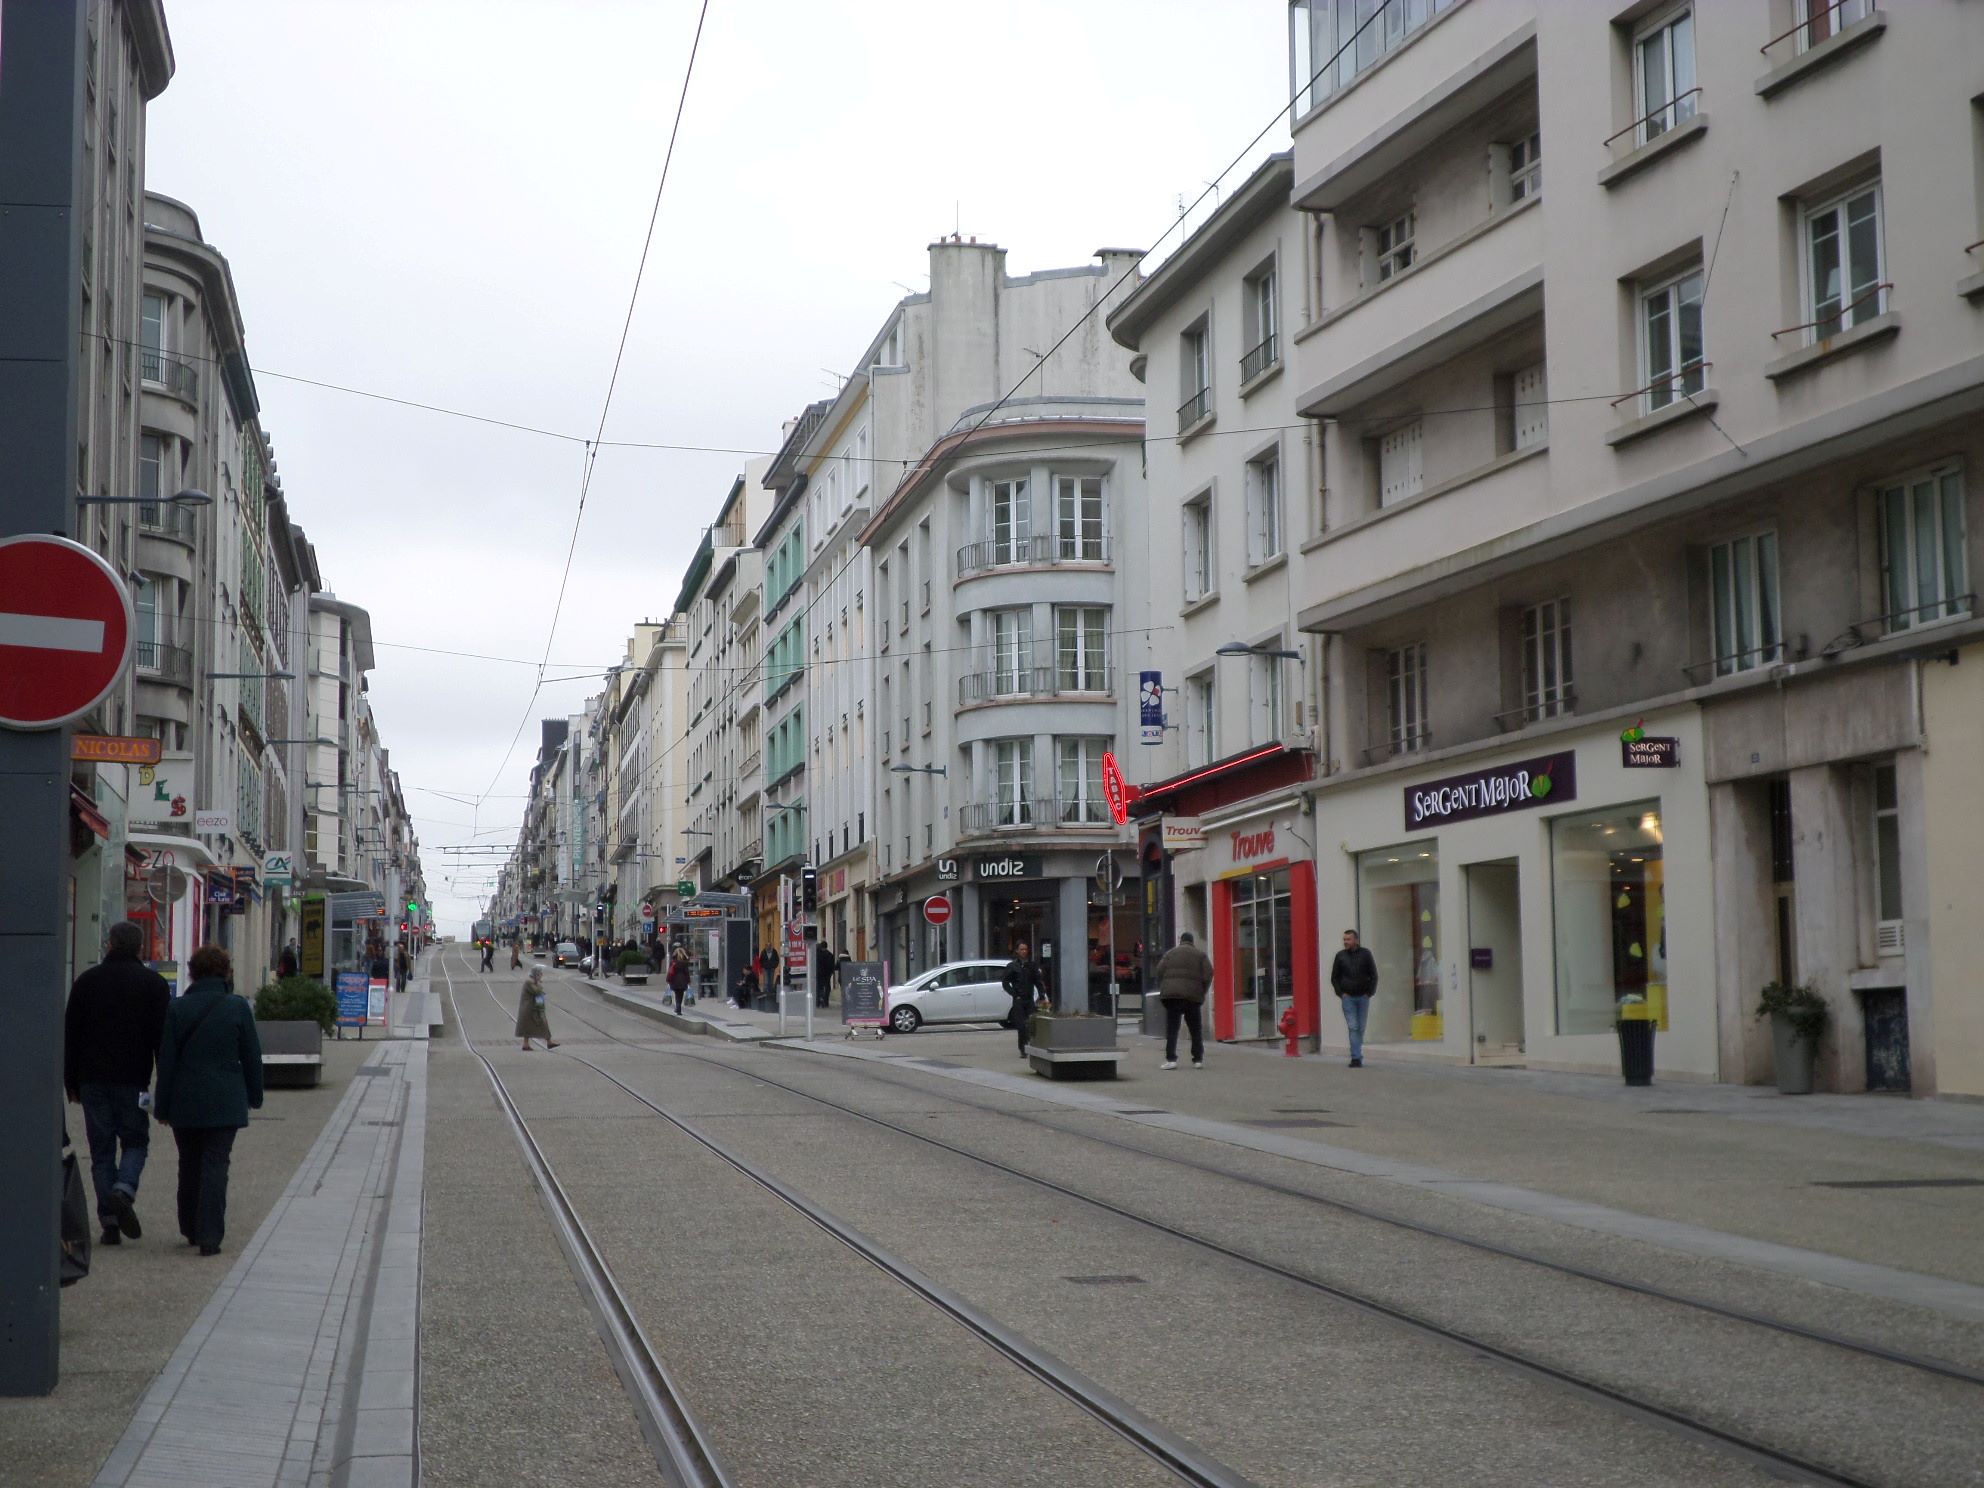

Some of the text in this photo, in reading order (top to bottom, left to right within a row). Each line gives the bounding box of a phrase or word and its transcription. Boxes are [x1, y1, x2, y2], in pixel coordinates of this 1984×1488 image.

[75, 740, 151, 757] NICOLAS
[1108, 766, 1123, 811] TABAC
[196, 817, 228, 827] eezo
[1166, 826, 1207, 836] Trouv
[1231, 820, 1275, 862] Trouvé
[980, 858, 1024, 876] undiz
